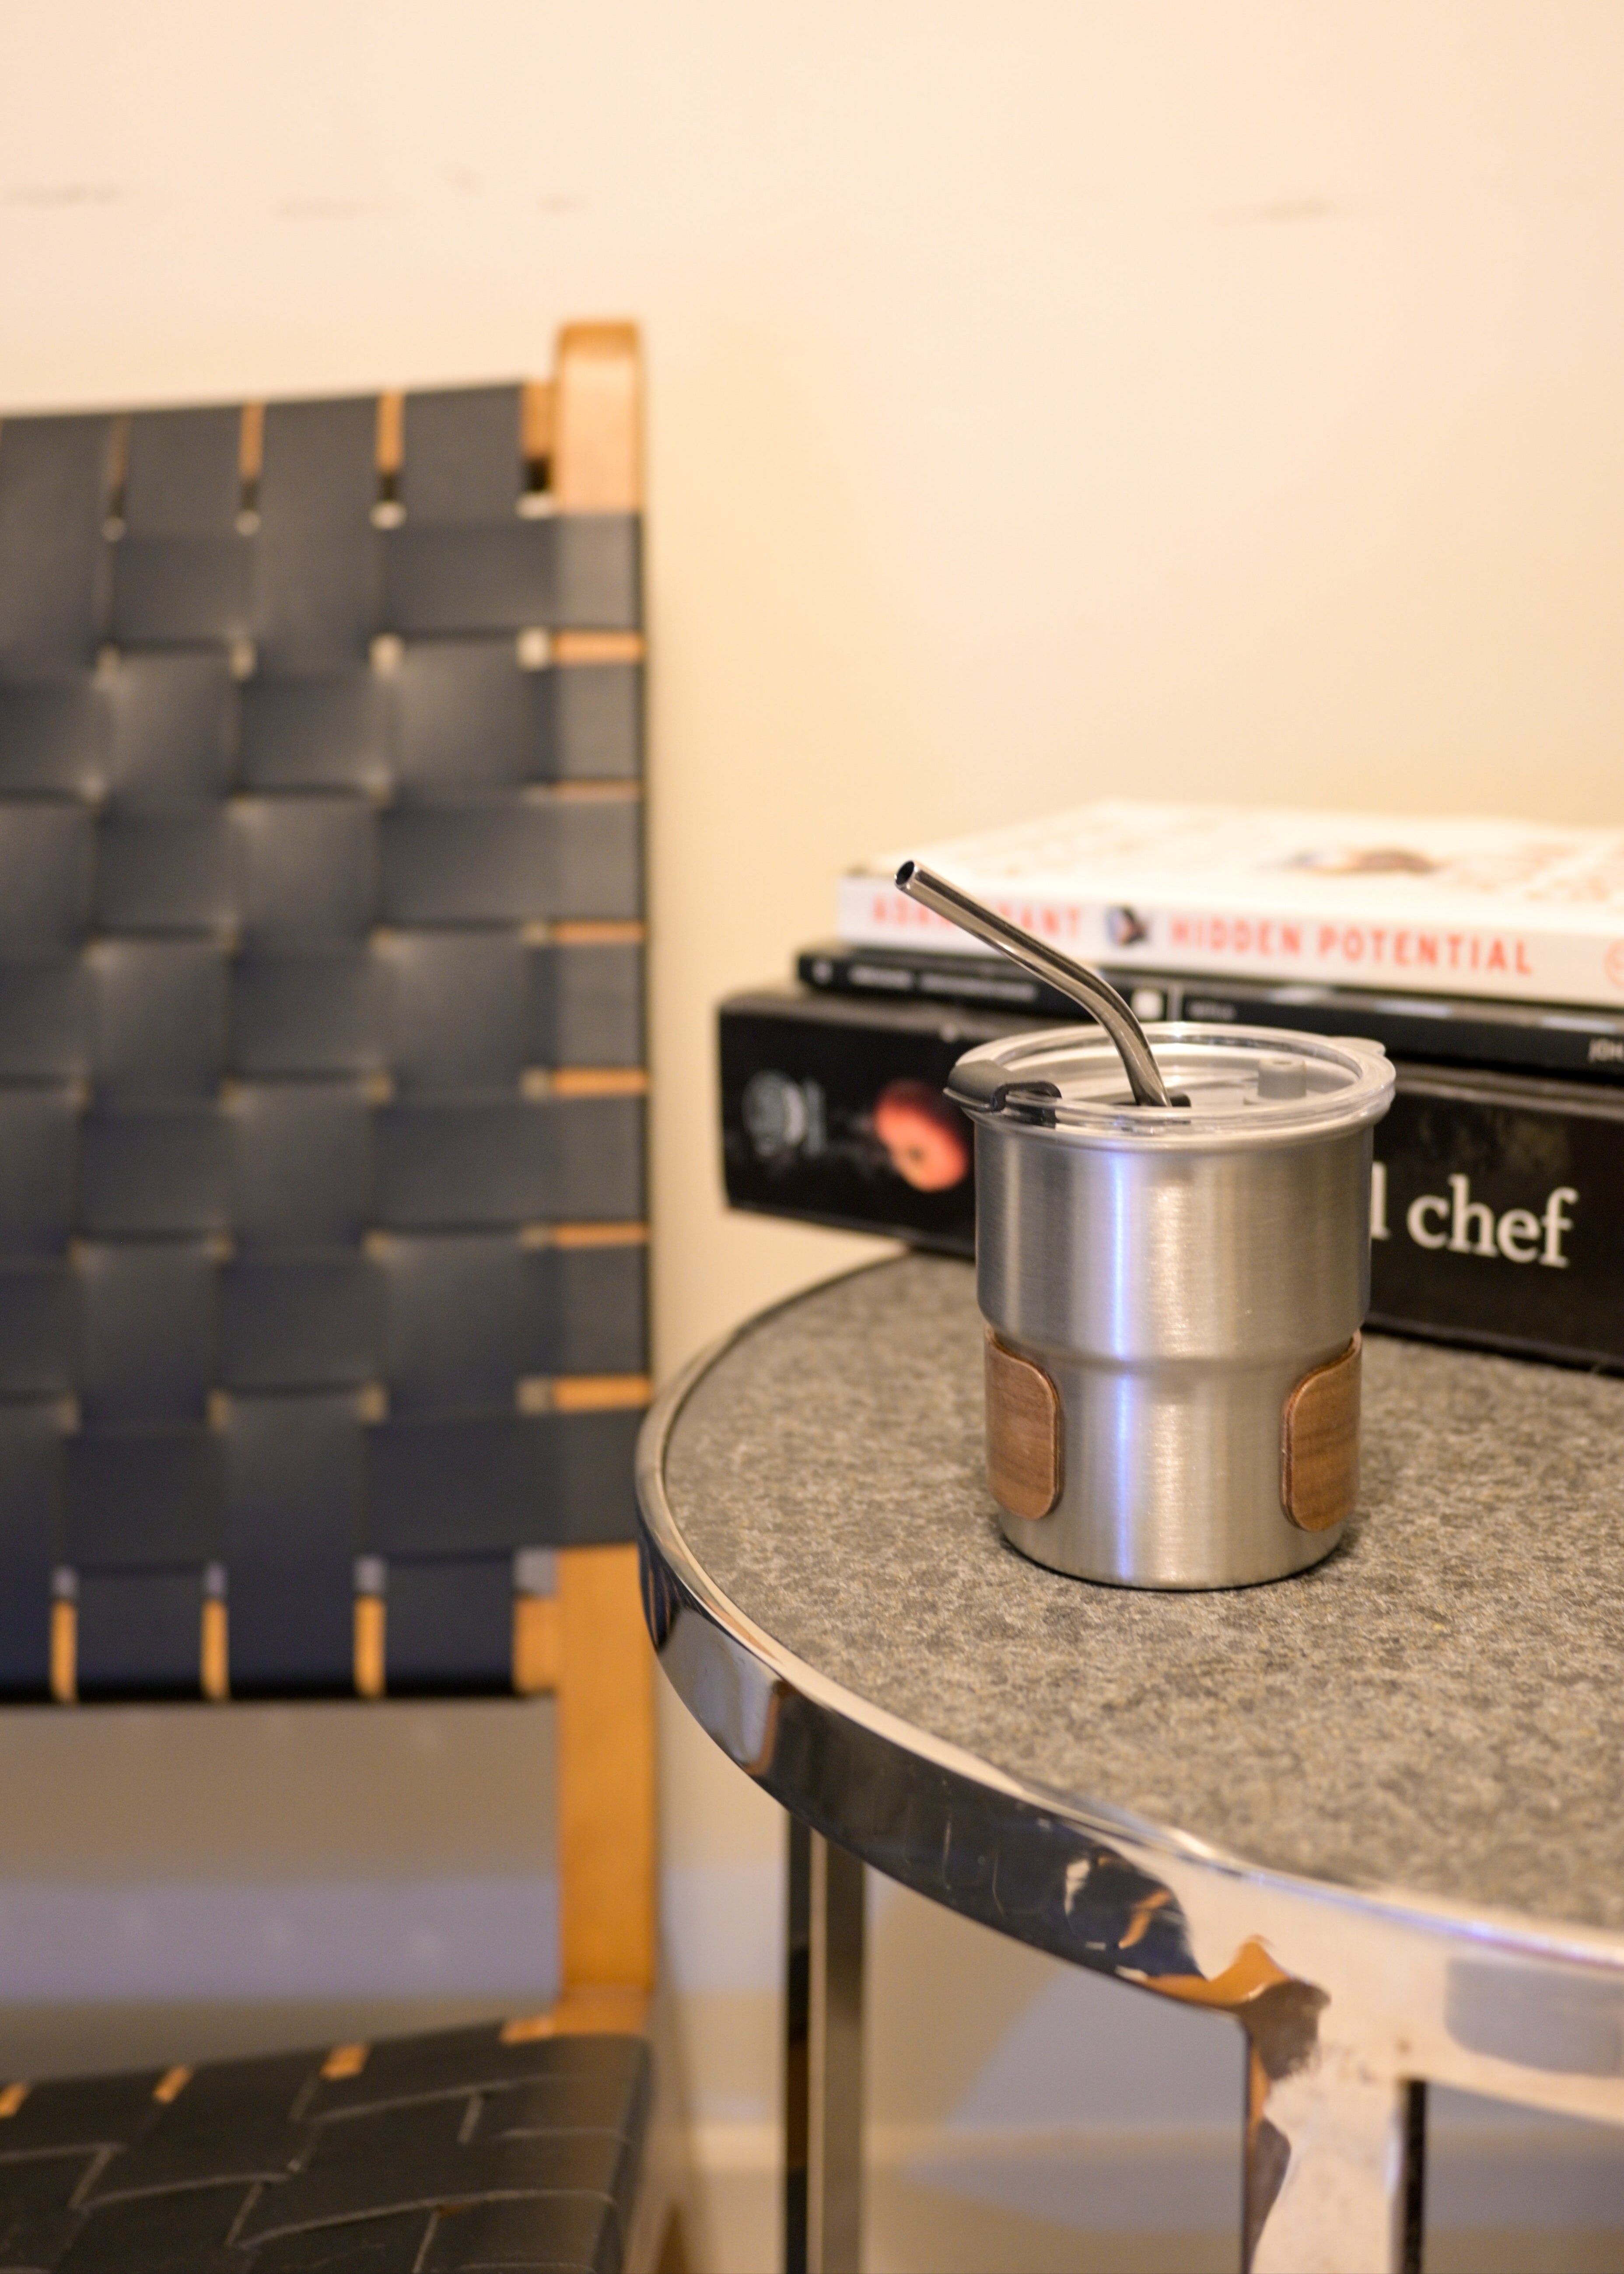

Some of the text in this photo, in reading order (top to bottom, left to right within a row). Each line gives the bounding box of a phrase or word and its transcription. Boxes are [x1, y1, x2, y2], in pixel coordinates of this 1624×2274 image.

[1170, 917, 1301, 956] HIDDEN
[1318, 923, 1532, 976] POTENTIAL
[1406, 1173, 1578, 1269] chef
